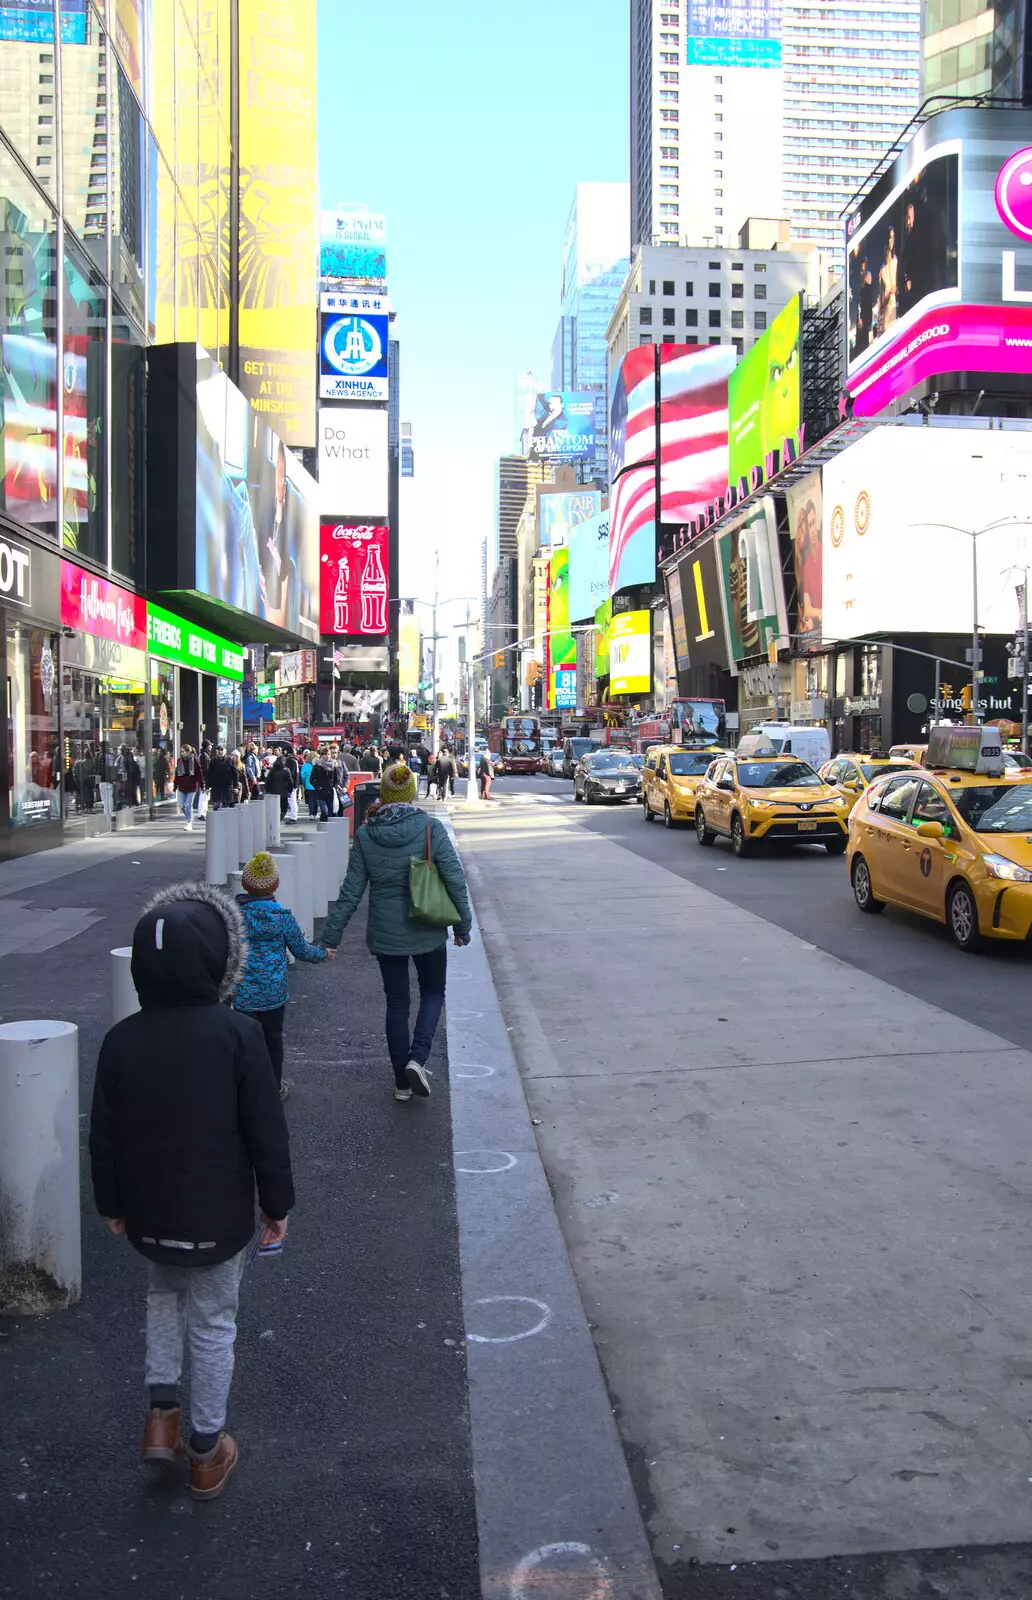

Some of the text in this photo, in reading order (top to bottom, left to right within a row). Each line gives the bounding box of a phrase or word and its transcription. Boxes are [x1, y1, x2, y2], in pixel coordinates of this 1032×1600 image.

[244, 361, 265, 376] GET
[335, 380, 374, 391] XINHUA
[326, 389, 383, 398] NEWS AGENCY
[324, 427, 346, 441] Do
[324, 445, 370, 459] What
[705, 423, 807, 528] BROADWAY
[990, 695, 1013, 710] hut
[983, 748, 1000, 756] 3D35
